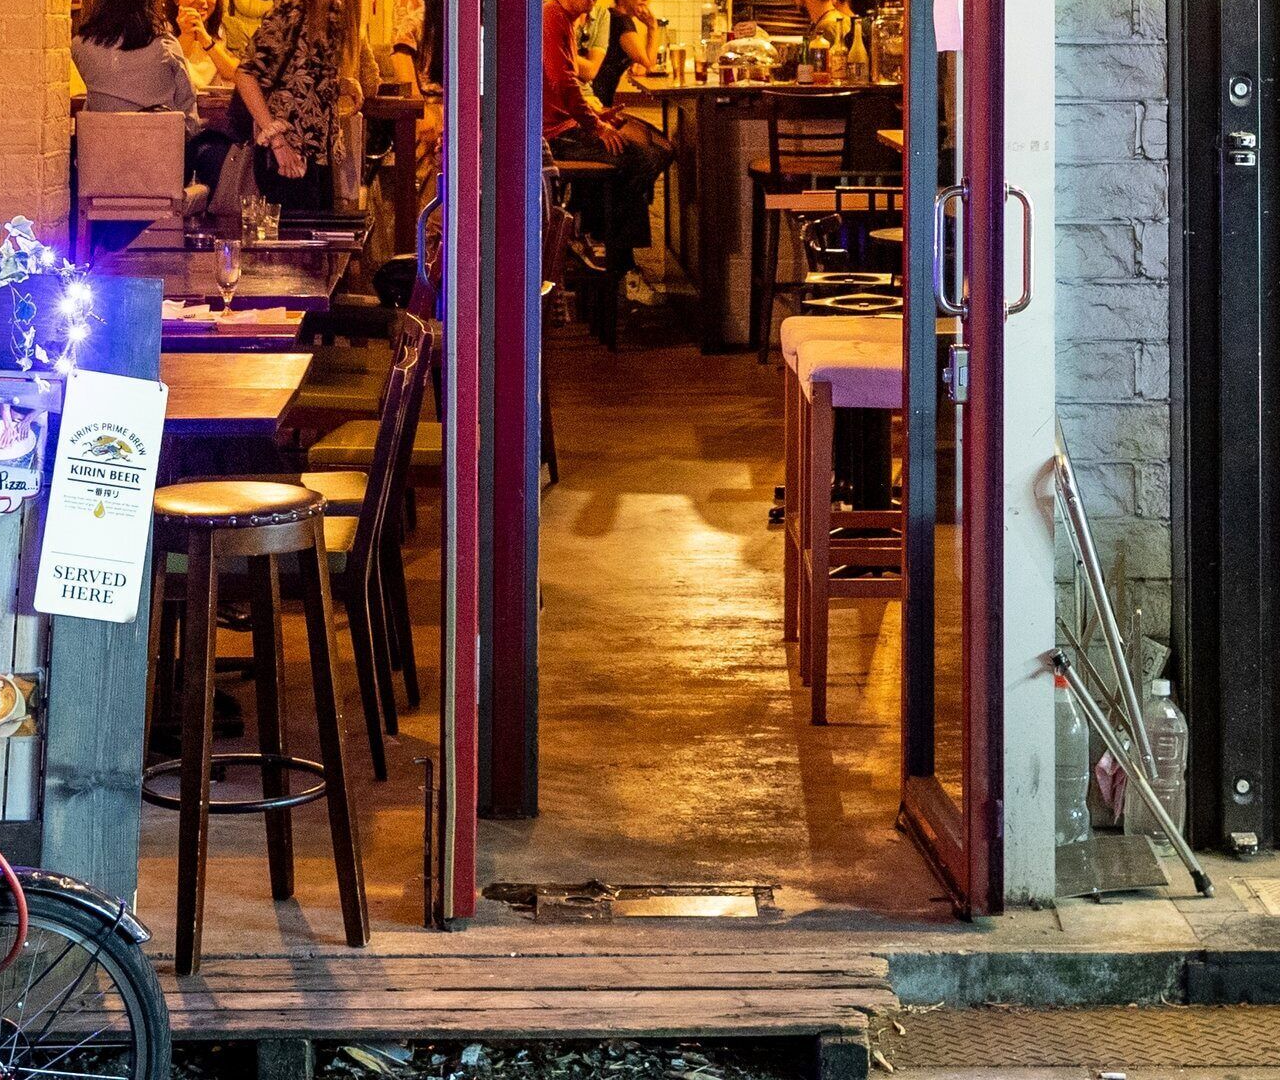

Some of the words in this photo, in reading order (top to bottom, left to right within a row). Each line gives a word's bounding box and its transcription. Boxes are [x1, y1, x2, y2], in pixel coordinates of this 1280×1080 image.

[70, 463, 106, 480] KIRIN
[109, 468, 141, 485] BEER
[52, 564, 128, 588] SERVED
[61, 583, 115, 605] HERE
